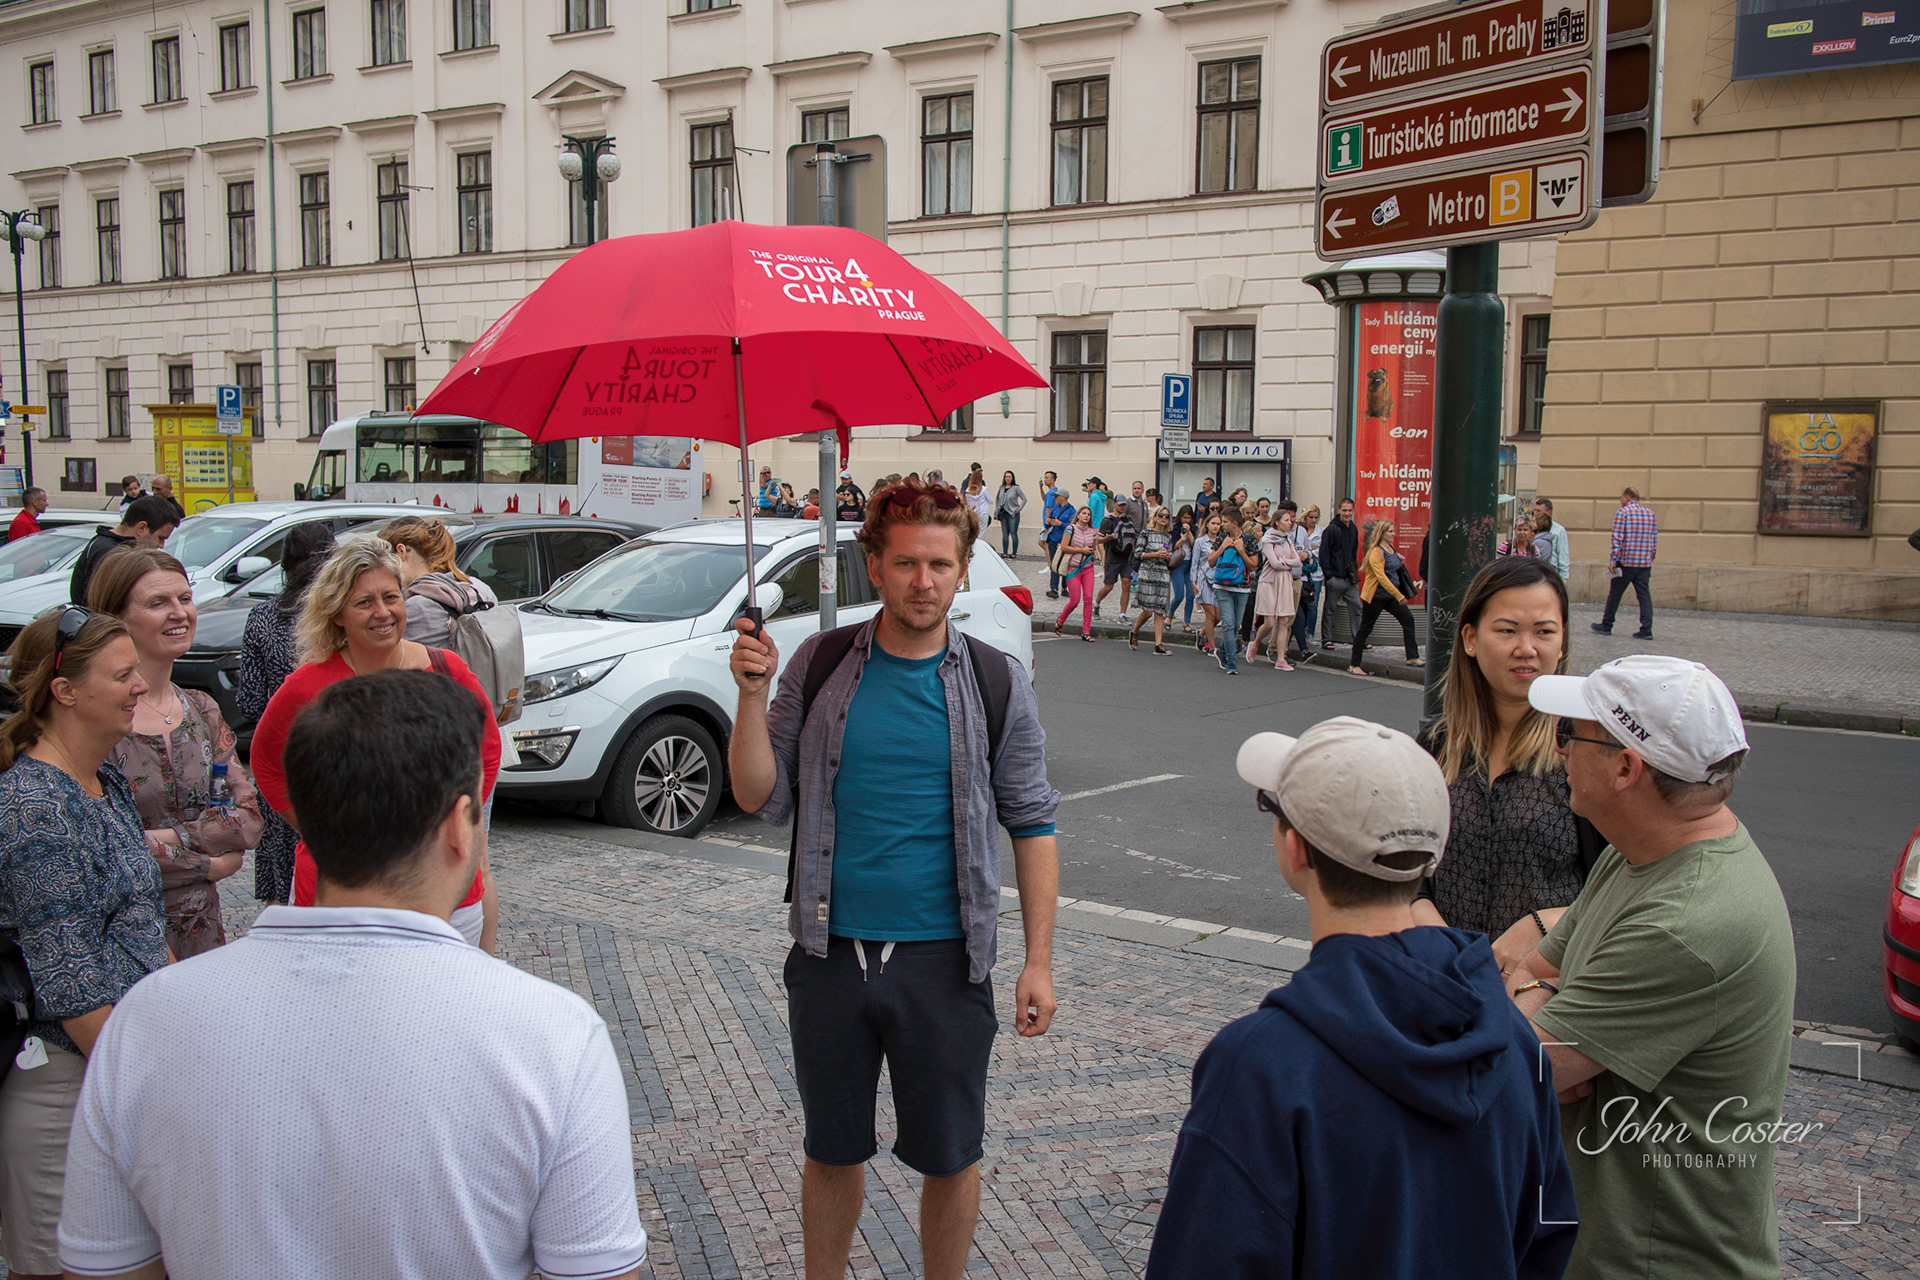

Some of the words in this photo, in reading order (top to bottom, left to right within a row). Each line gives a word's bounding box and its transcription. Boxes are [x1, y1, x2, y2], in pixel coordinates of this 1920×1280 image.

[1863, 14, 1896, 26] Prima
[1369, 45, 1430, 83] Muzeum
[1437, 31, 1455, 67] hl.
[1462, 33, 1481, 62] m.
[1488, 13, 1537, 56] Prahy
[1812, 41, 1855, 53] EXKLUZIV
[1367, 113, 1444, 160] Turistické
[1449, 102, 1539, 145] informace
[1428, 191, 1485, 227] Metro
[1500, 178, 1521, 217] B
[748, 248, 773, 260] THE
[776, 253, 834, 265] ORIGINAL
[782, 283, 916, 308] CHARITY
[877, 309, 926, 321] PRAGUE
[1364, 318, 1381, 327] Tady
[1383, 310, 1437, 326] hlídám
[1403, 327, 1437, 342] ceny
[1370, 340, 1423, 358] energií
[223, 388, 236, 408] P
[1170, 379, 1185, 408] P
[1799, 431, 1842, 451] GO
[1360, 470, 1376, 480] Tady
[1379, 464, 1432, 479] hlídám
[1398, 480, 1432, 495] ceny
[1366, 493, 1419, 511] energií
[1611, 704, 1651, 742] PENN
